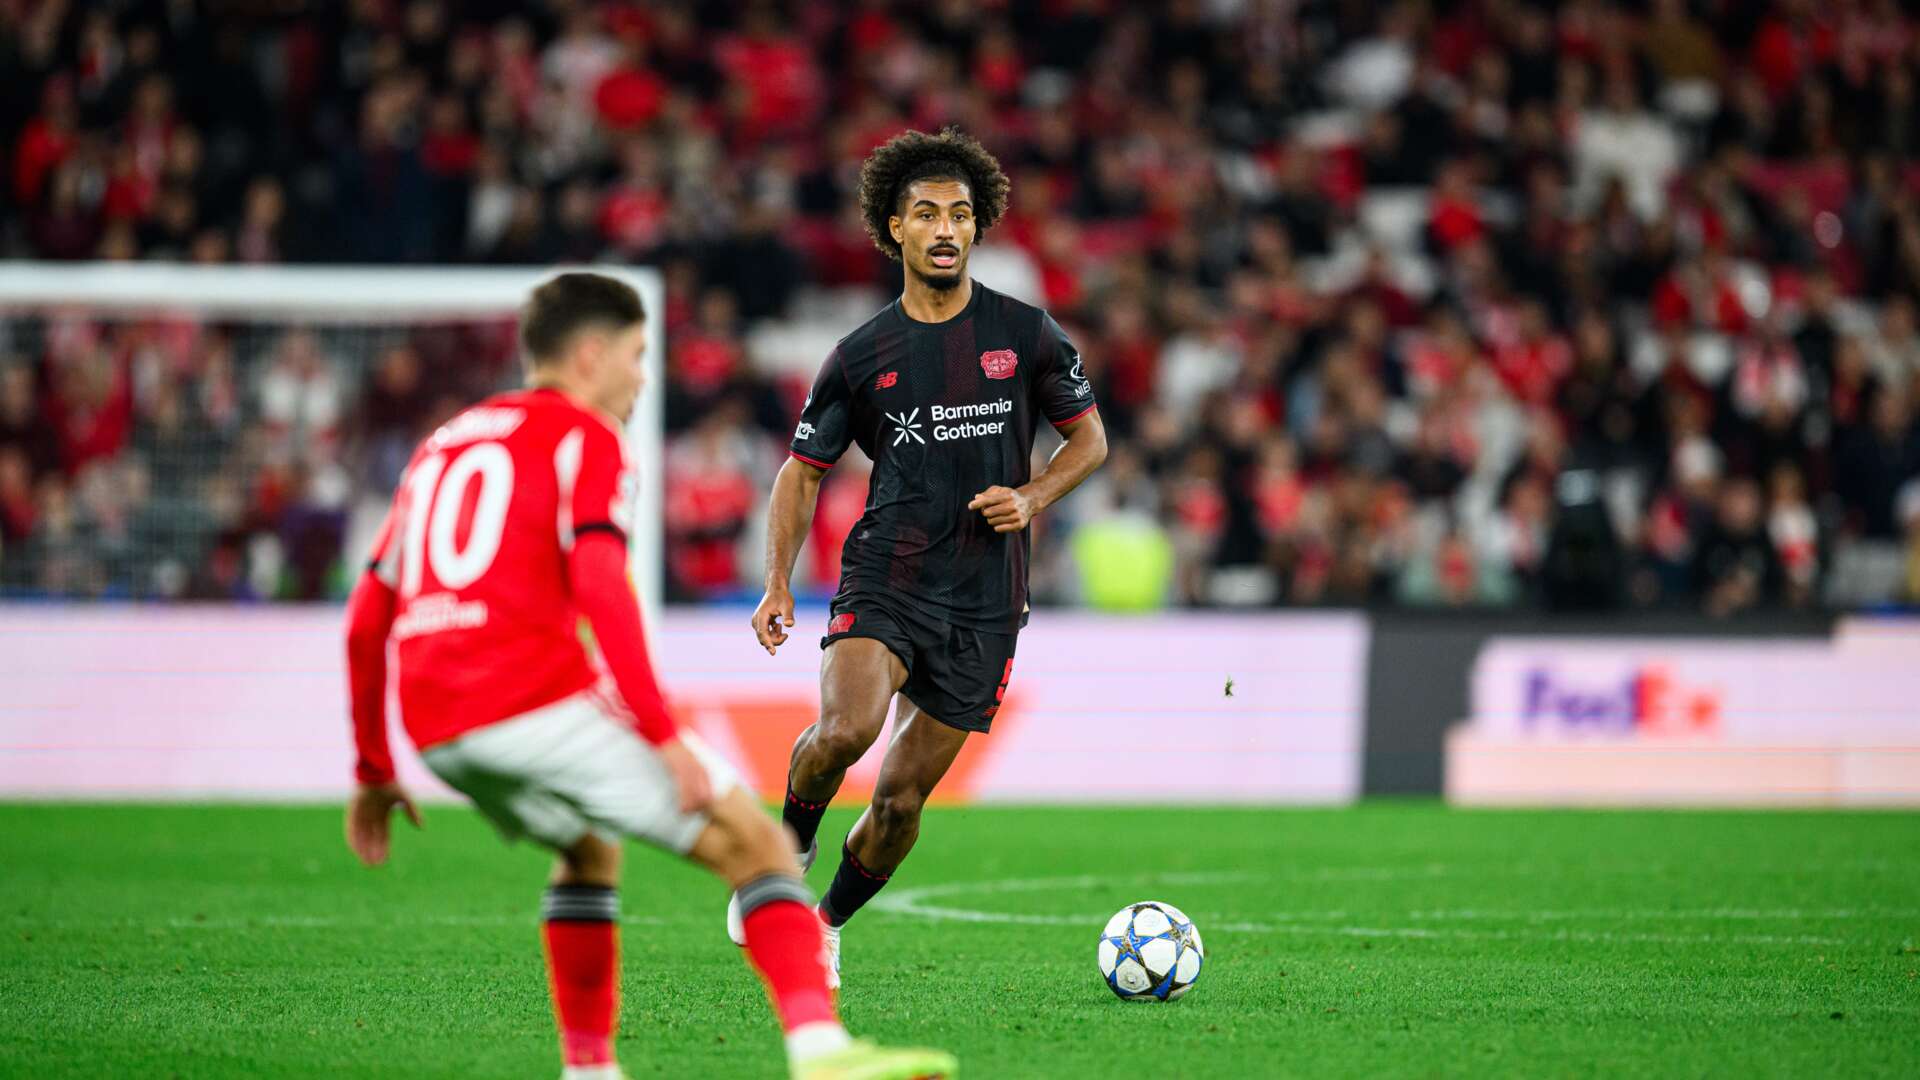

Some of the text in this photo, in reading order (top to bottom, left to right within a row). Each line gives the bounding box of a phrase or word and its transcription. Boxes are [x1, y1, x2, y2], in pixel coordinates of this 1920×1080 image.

[931, 398, 1013, 422] Barmenia
[932, 421, 1005, 441] Gothaer
[400, 441, 516, 601] 10
[1522, 670, 1719, 732] FedEx
